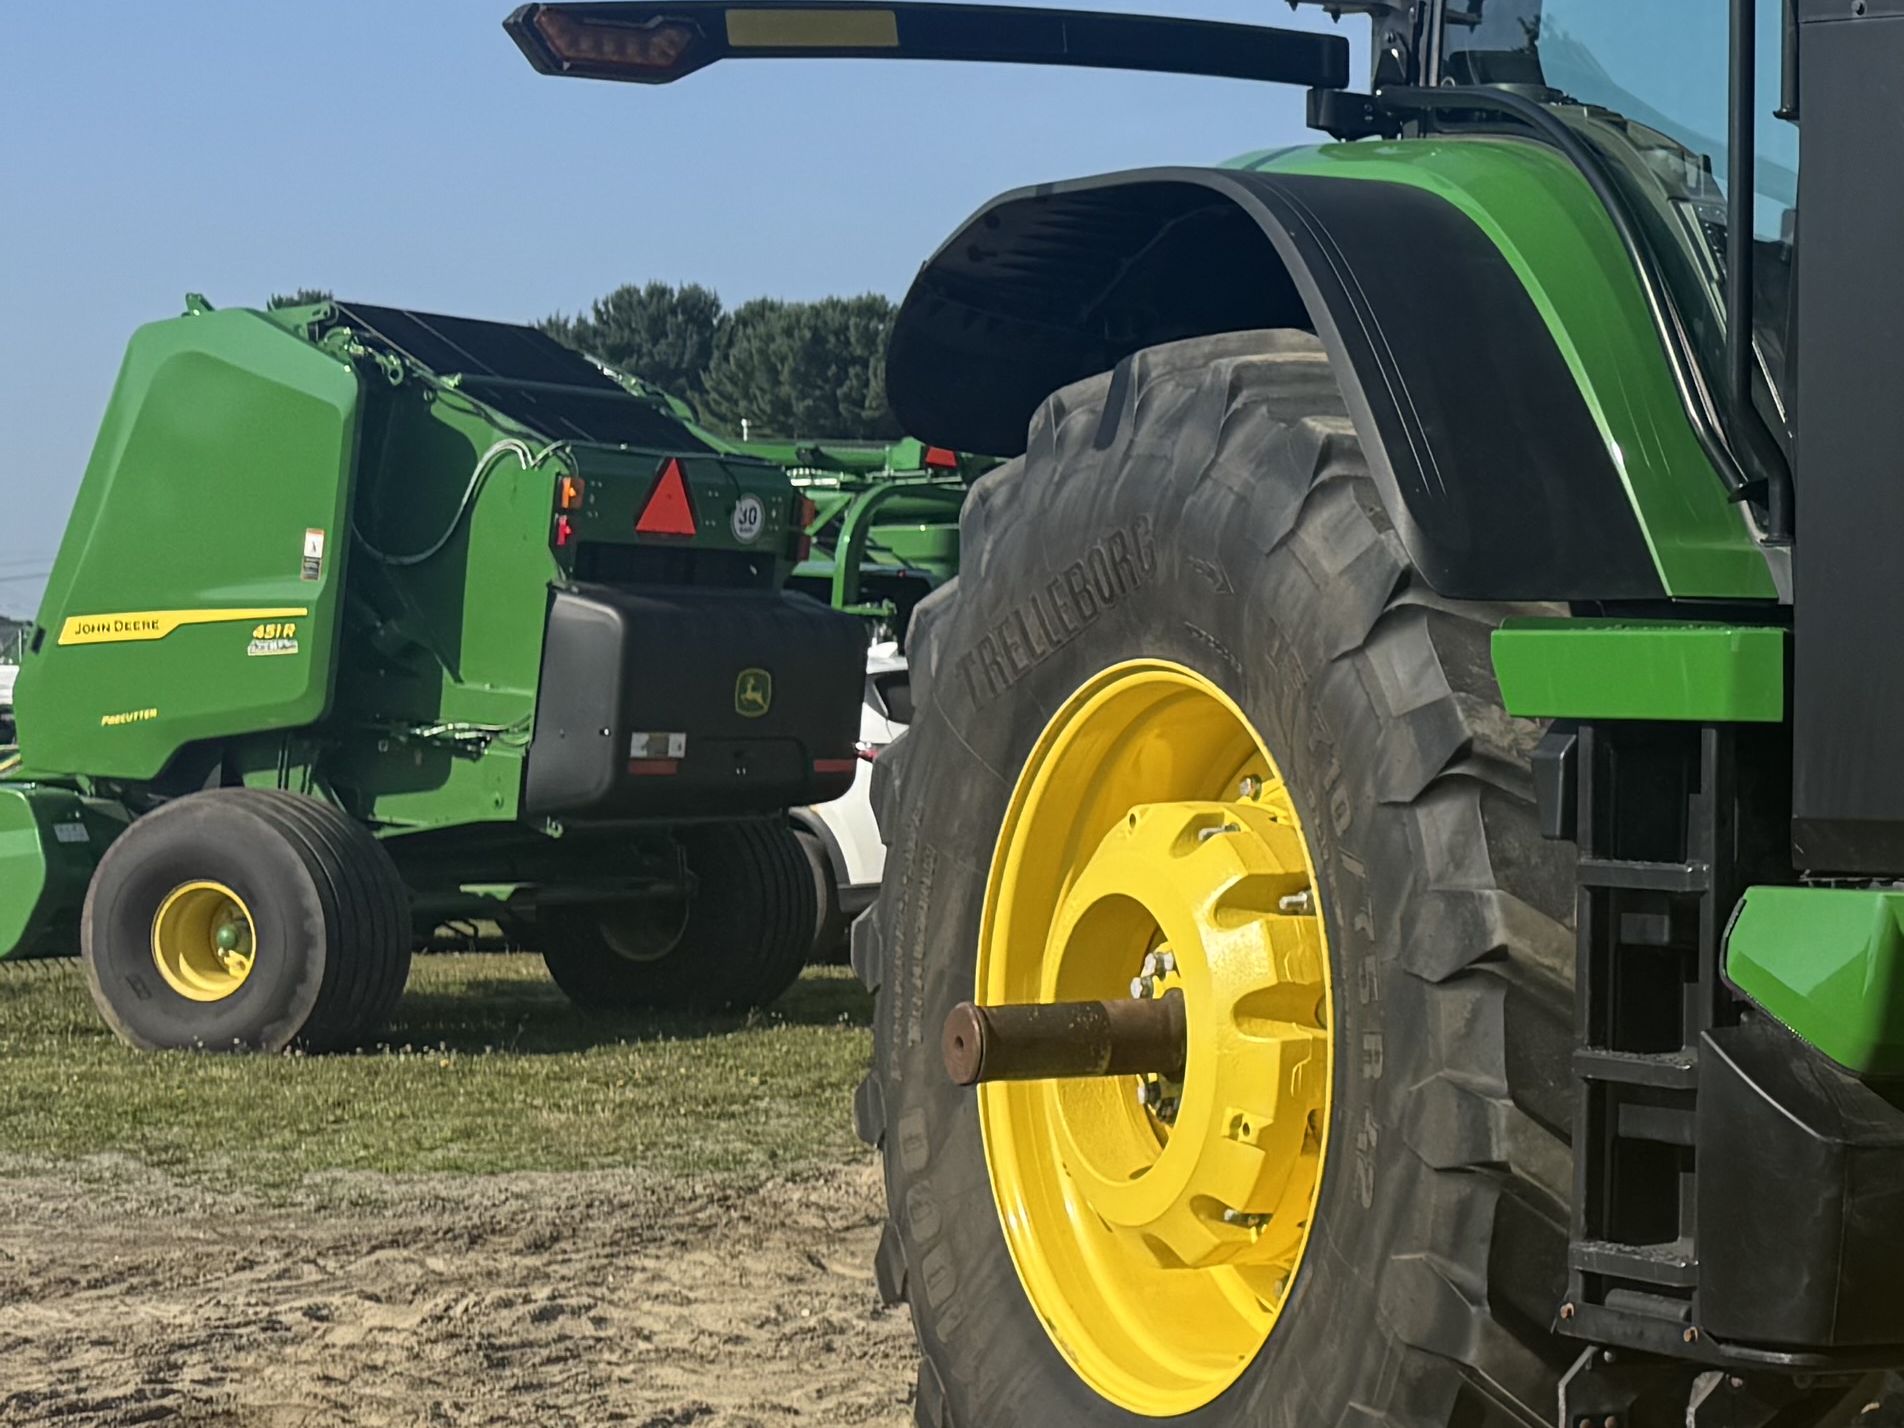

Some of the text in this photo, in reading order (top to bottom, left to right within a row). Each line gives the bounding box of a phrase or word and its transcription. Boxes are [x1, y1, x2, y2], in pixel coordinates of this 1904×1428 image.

[75, 619, 160, 635] JOHN DEERE
[955, 514, 1158, 713] TRELLEBORG
